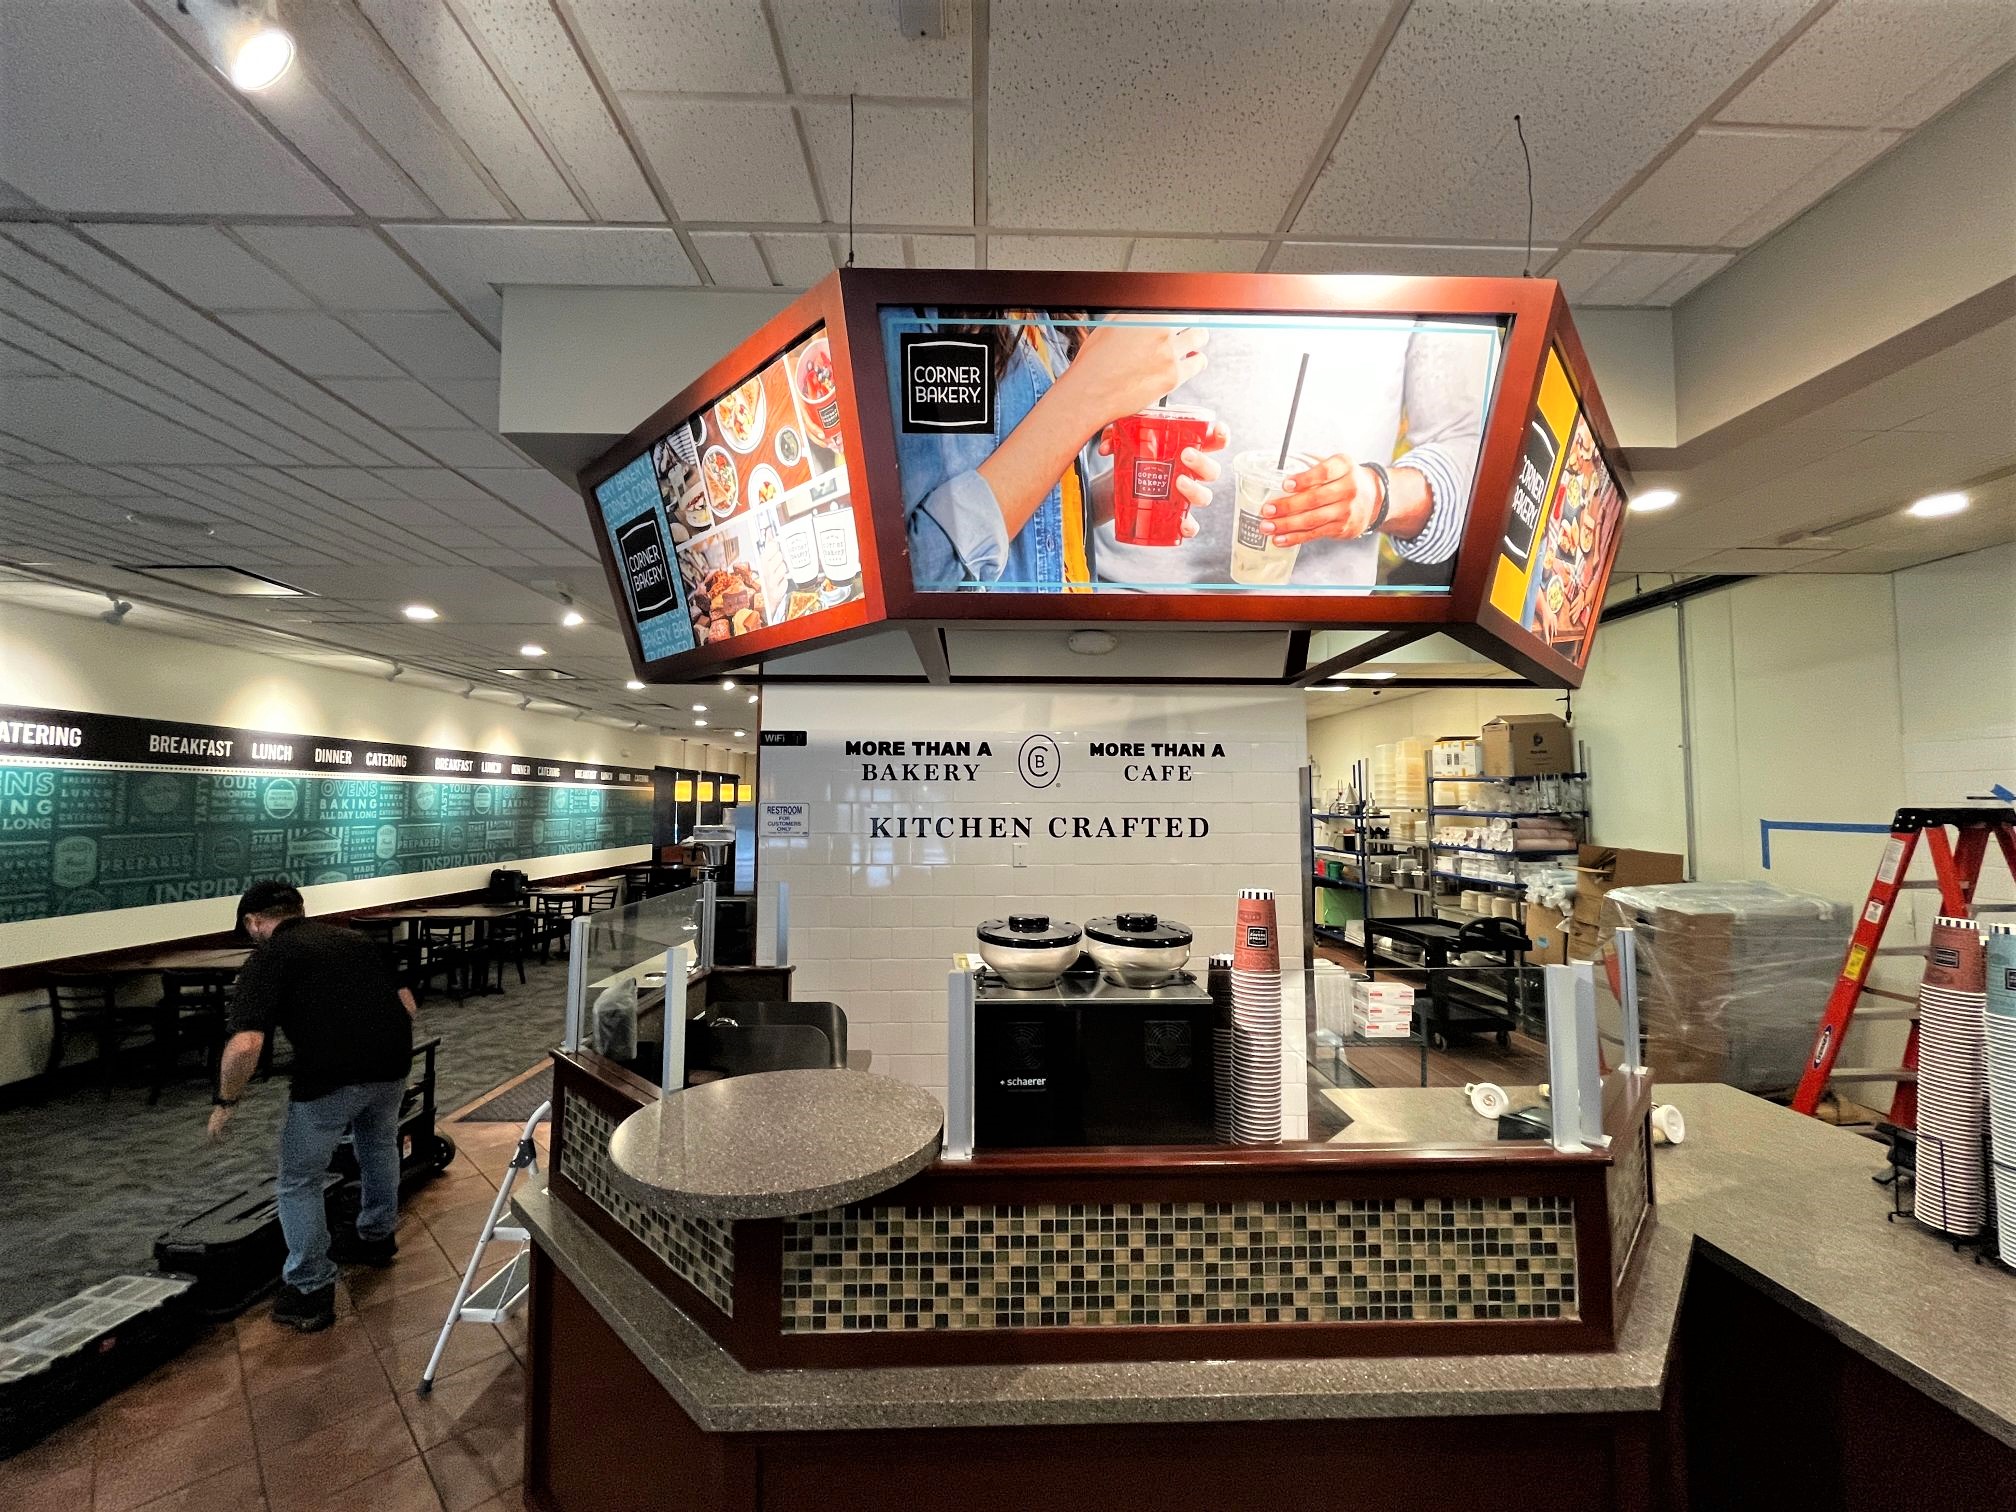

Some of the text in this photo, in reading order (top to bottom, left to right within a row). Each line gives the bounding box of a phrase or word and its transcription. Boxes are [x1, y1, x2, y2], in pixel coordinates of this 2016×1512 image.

[914, 366, 981, 384] CORNER
[1138, 472, 1168, 480] corner
[1138, 478, 1168, 488] bakery
[1519, 454, 1545, 504] ORNER
[628, 544, 661, 573] CORNER
[0, 721, 82, 748] ATERING
[149, 734, 233, 757] BREAKFAST
[252, 742, 293, 761] LUNCH
[315, 748, 352, 765] DINNER
[366, 751, 407, 768] CATERING
[434, 757, 474, 772] BREAKFAST
[481, 761, 502, 774] LUNCH
[846, 741, 992, 756] MORE THAN A
[1090, 743, 1225, 757] MORE THAN A
[862, 764, 981, 781] BAKERY
[1124, 765, 1192, 782] CAFE
[212, 776, 257, 789] YOUR
[321, 780, 378, 797] OVENS
[449, 783, 472, 793] YOUR
[320, 798, 377, 810] BAKING
[441, 784, 449, 818] TASTY
[320, 810, 377, 820] ALL DAY LONG
[767, 806, 802, 815] RESTROOM
[2, 818, 52, 830] LONG
[870, 817, 1209, 838] KITCHEN CRAFTED
[422, 851, 497, 872] INSPIRATION
[155, 871, 305, 904] INSPIRAON
[1007, 1076, 1047, 1086] schaerer
